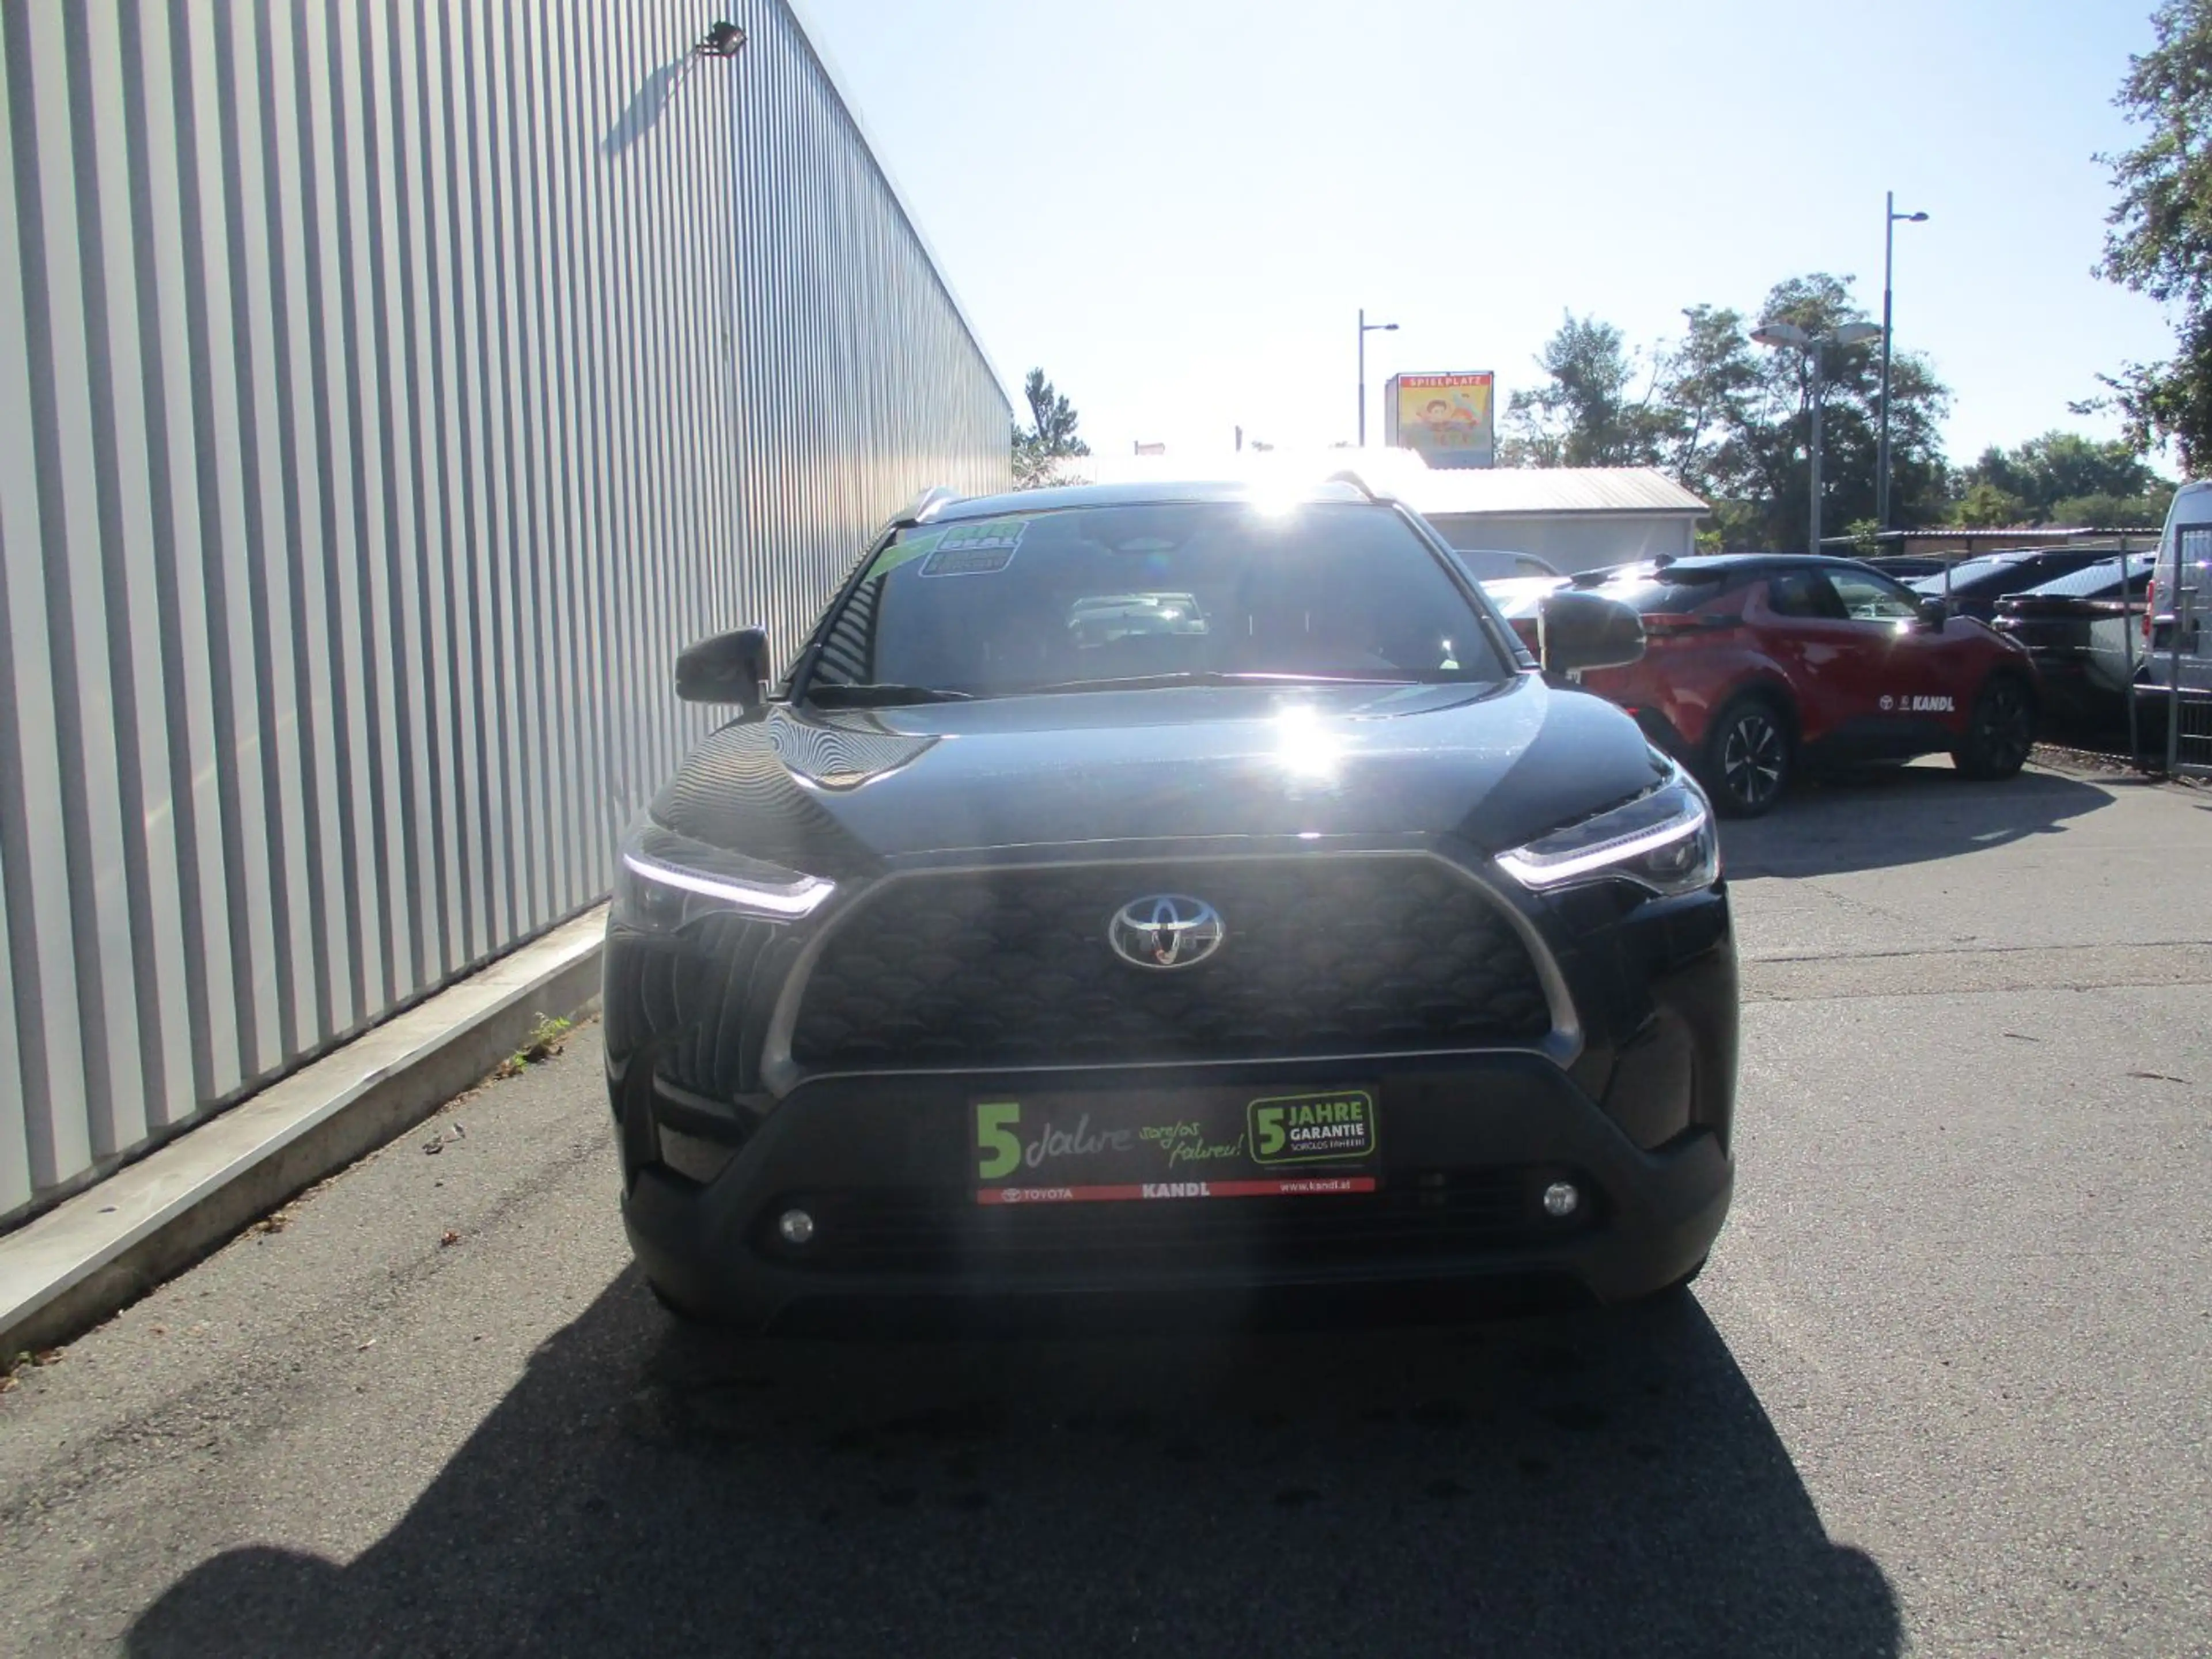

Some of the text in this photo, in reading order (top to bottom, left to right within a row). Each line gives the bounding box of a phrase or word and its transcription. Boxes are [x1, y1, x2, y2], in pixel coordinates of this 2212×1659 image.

[1410, 376, 1482, 387] SPIELPLATZ
[1912, 695, 1955, 712] KANDL
[1289, 1101, 1363, 1126] JAHRE
[1257, 1107, 1286, 1154] 5
[1290, 1123, 1365, 1141] GARANTIE
[977, 1103, 1135, 1179] 5 Jahre
[1024, 1188, 1073, 1200] TOYOTA
[1142, 1181, 1211, 1199] KANDL
[1280, 1179, 1351, 1192] www.kandl.at
